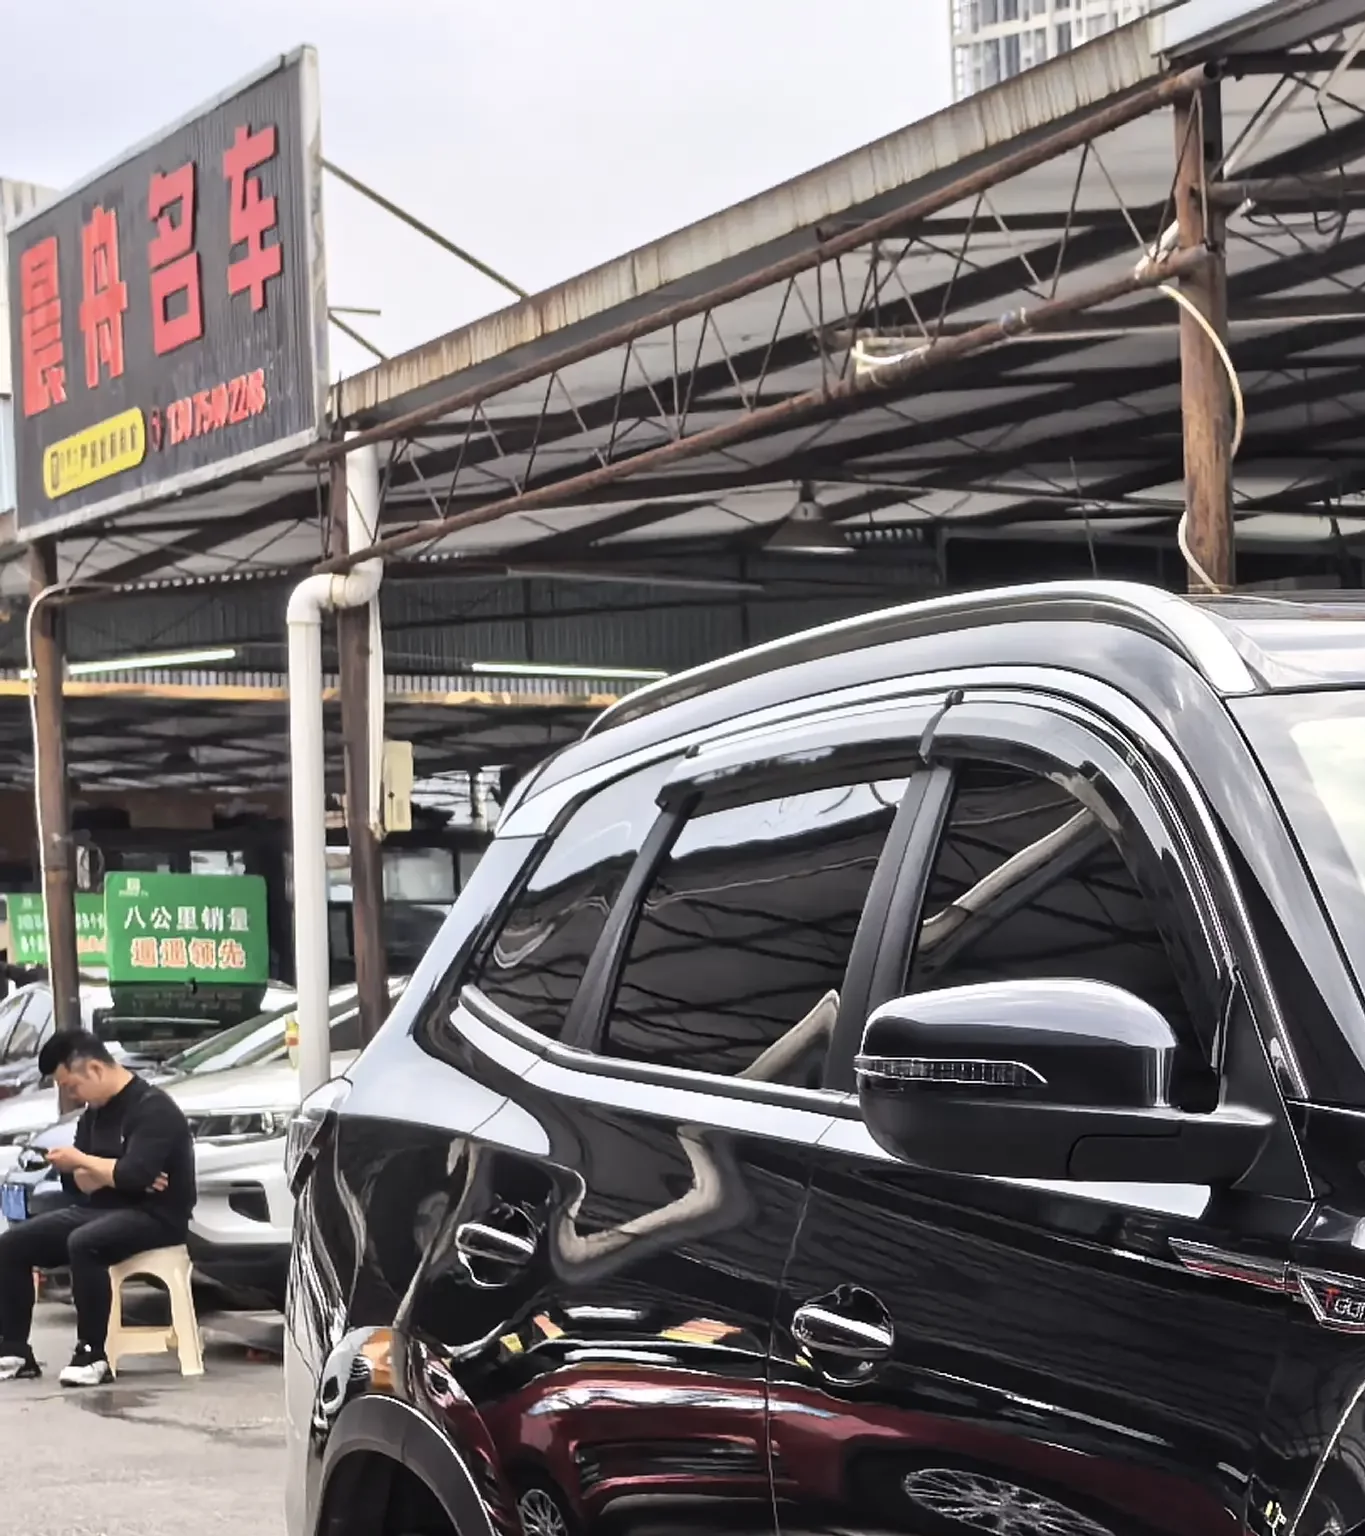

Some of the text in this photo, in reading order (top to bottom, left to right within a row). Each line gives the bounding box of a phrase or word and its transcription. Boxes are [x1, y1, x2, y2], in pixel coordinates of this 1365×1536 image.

[20, 123, 283, 417] 晨舟名车
[124, 904, 249, 931] 八公里销量
